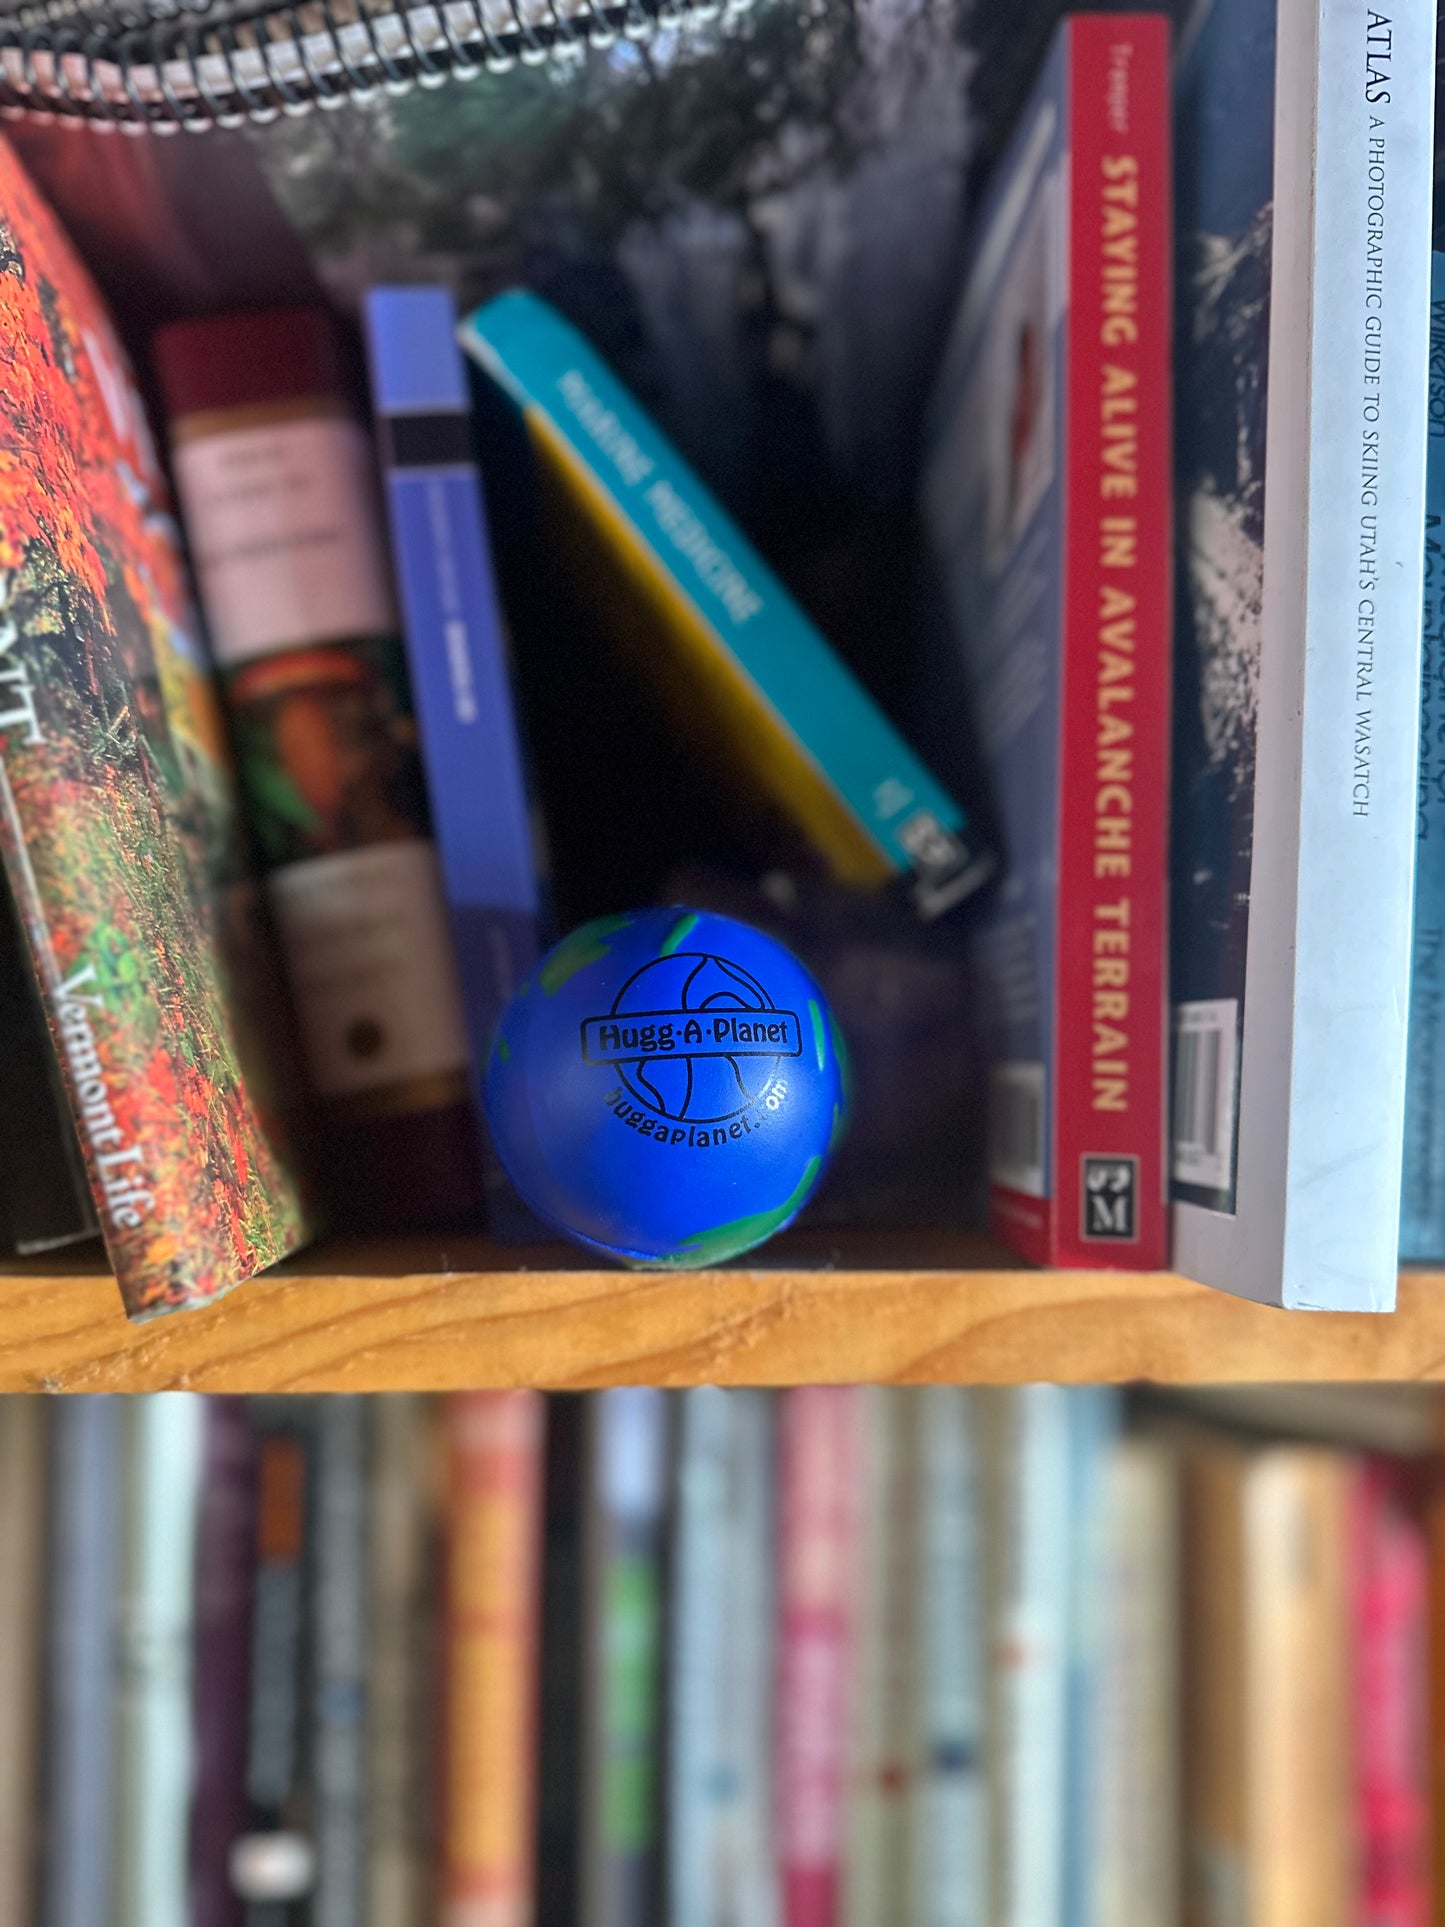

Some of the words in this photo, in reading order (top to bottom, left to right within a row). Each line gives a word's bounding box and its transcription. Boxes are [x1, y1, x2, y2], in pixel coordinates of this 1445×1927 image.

[1365, 8, 1393, 104] ATLAS
[1368, 114, 1386, 130] A
[1101, 154, 1139, 347] STAYING
[1366, 138, 1385, 309] PHOTOGRAPHIC
[1364, 316, 1382, 385] GUIDE
[1101, 364, 1138, 498] ALIVE
[1363, 392, 1380, 422] TO
[1360, 430, 1379, 506] SKIING
[1101, 517, 1137, 568] IN
[1359, 515, 1379, 591] UTAH'S
[1356, 599, 1375, 701] CENTRAL
[1095, 585, 1136, 878] AVALANCHE
[1353, 709, 1371, 817] WASATCH
[1092, 897, 1131, 1112] TERRAIN
[54, 964, 125, 1149] Vermont
[97, 1144, 156, 1229] Life
